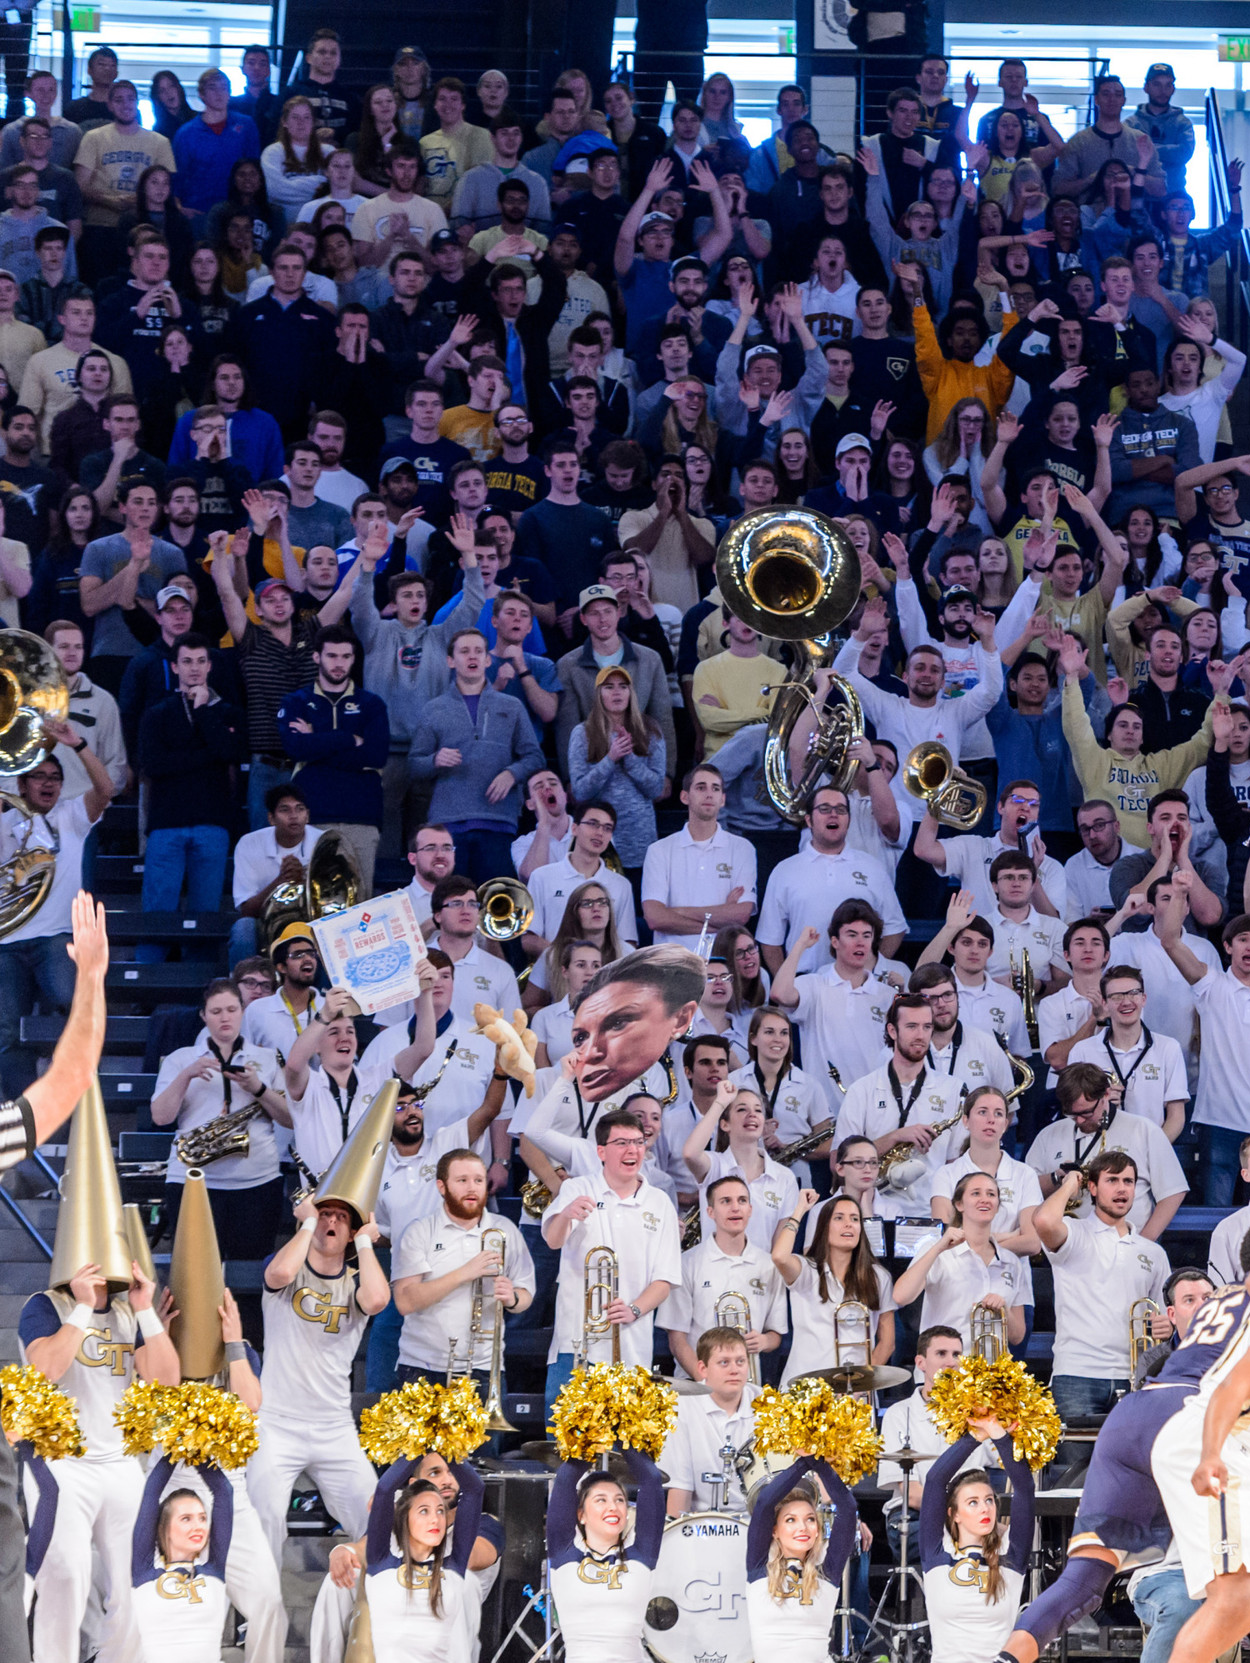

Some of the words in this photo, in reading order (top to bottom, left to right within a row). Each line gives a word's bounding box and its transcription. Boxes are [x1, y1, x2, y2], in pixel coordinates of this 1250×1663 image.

[803, 311, 854, 341] TECH
[1154, 426, 1179, 440] TECH
[413, 454, 440, 470] GT
[514, 470, 537, 498] TECH
[1015, 527, 1068, 543] GEIA
[1108, 766, 1160, 785] GEORGIA
[1123, 783, 1145, 799] GT
[354, 932, 387, 951] REWARDS
[473, 976, 491, 987] GT
[455, 1048, 479, 1064] GT
[967, 1059, 984, 1071] GT
[1141, 1063, 1160, 1076] GT
[928, 1094, 946, 1107] GT
[763, 1190, 782, 1205] GT
[642, 1211, 660, 1226] GT
[1137, 1253, 1153, 1267] GT
[749, 1277, 767, 1290] GT
[292, 1286, 349, 1333] GT
[1178, 1298, 1243, 1349] 35
[75, 1327, 135, 1376] GT
[693, 1523, 739, 1537] YAMAHA
[1212, 1539, 1238, 1556] GT
[577, 1555, 628, 1590] GT
[156, 1570, 206, 1604] GT
[683, 1570, 747, 1619] GT
